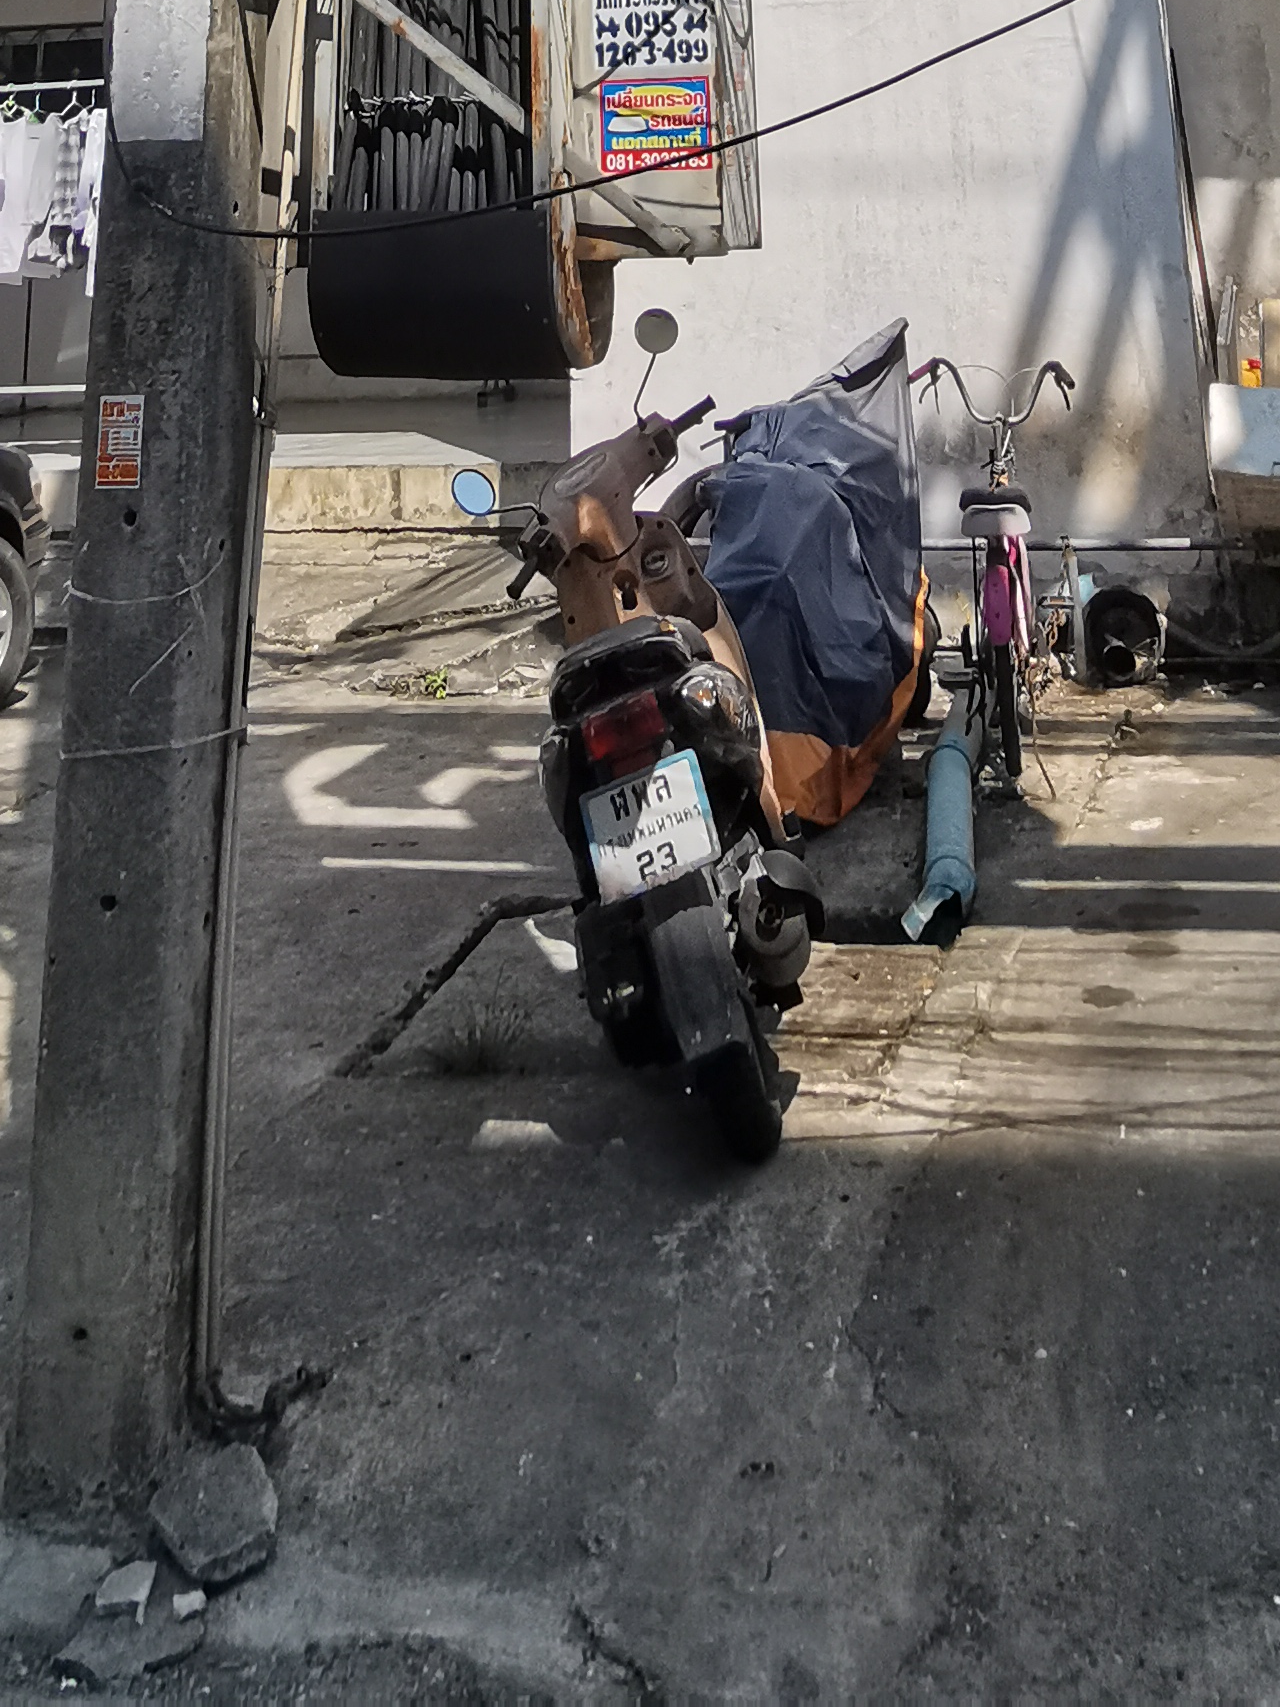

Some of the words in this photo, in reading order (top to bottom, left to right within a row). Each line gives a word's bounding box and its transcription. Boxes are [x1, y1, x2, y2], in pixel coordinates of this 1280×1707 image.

[624, 10, 678, 39] 095
[606, 87, 704, 110] เปลี่ยนกระจก
[636, 840, 678, 882] 23
